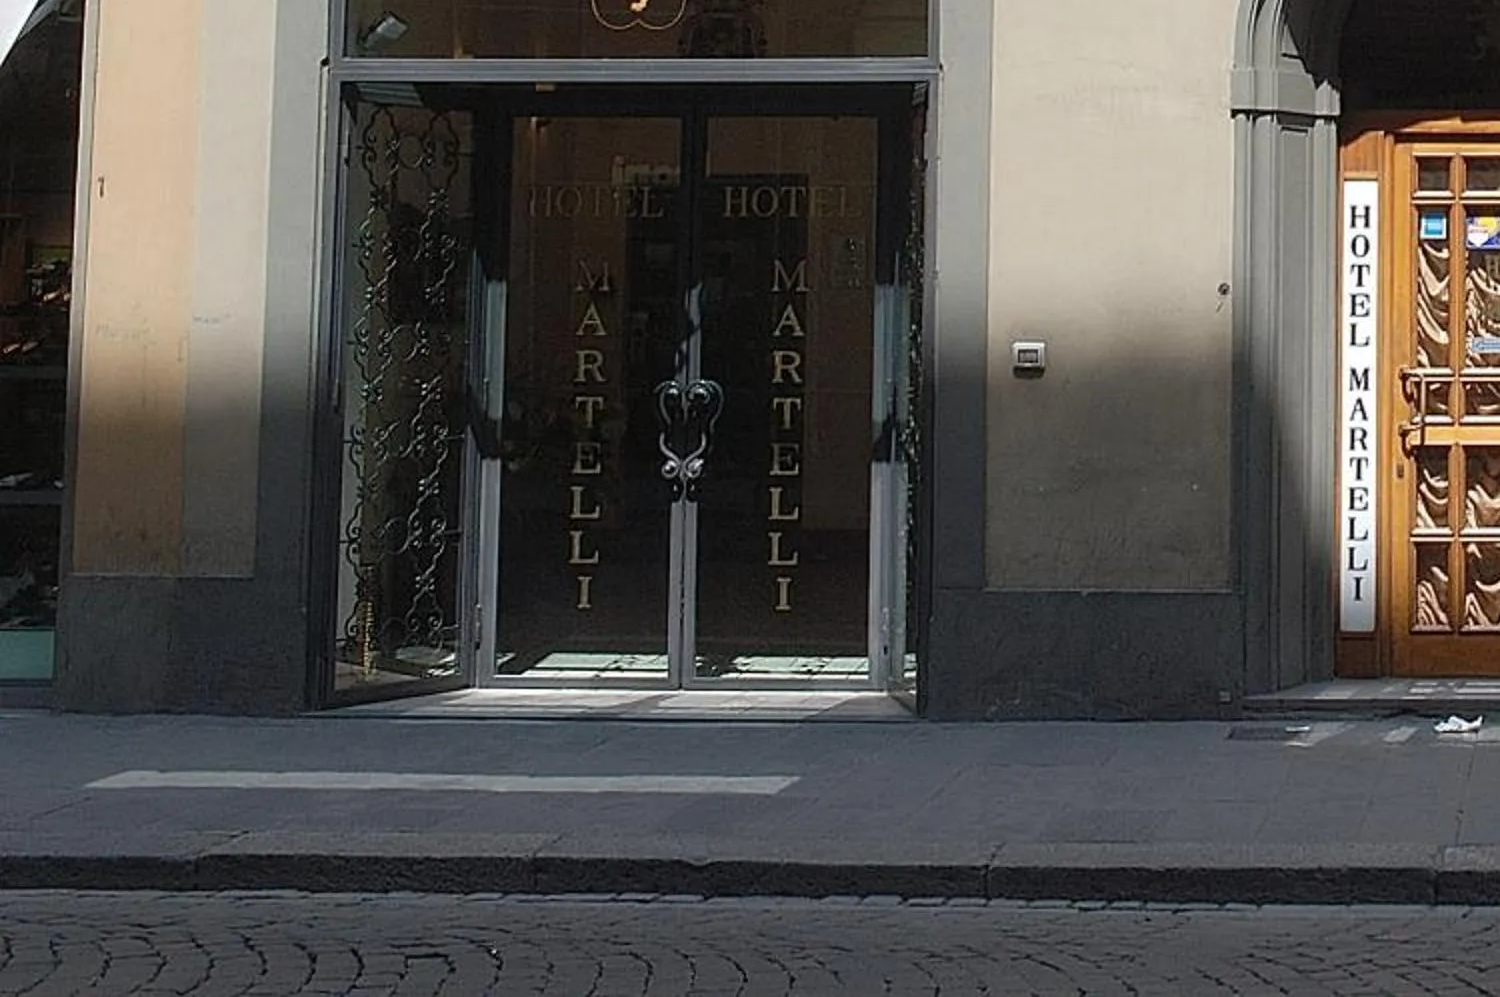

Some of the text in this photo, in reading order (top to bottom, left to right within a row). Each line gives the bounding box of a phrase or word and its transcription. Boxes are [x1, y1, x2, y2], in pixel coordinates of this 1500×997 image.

[724, 185, 863, 218] HOTEL
[568, 259, 609, 609] MARTELLI
[767, 259, 809, 611] MARTELLI
[1347, 205, 1371, 601] HOTEL MARTELLI
